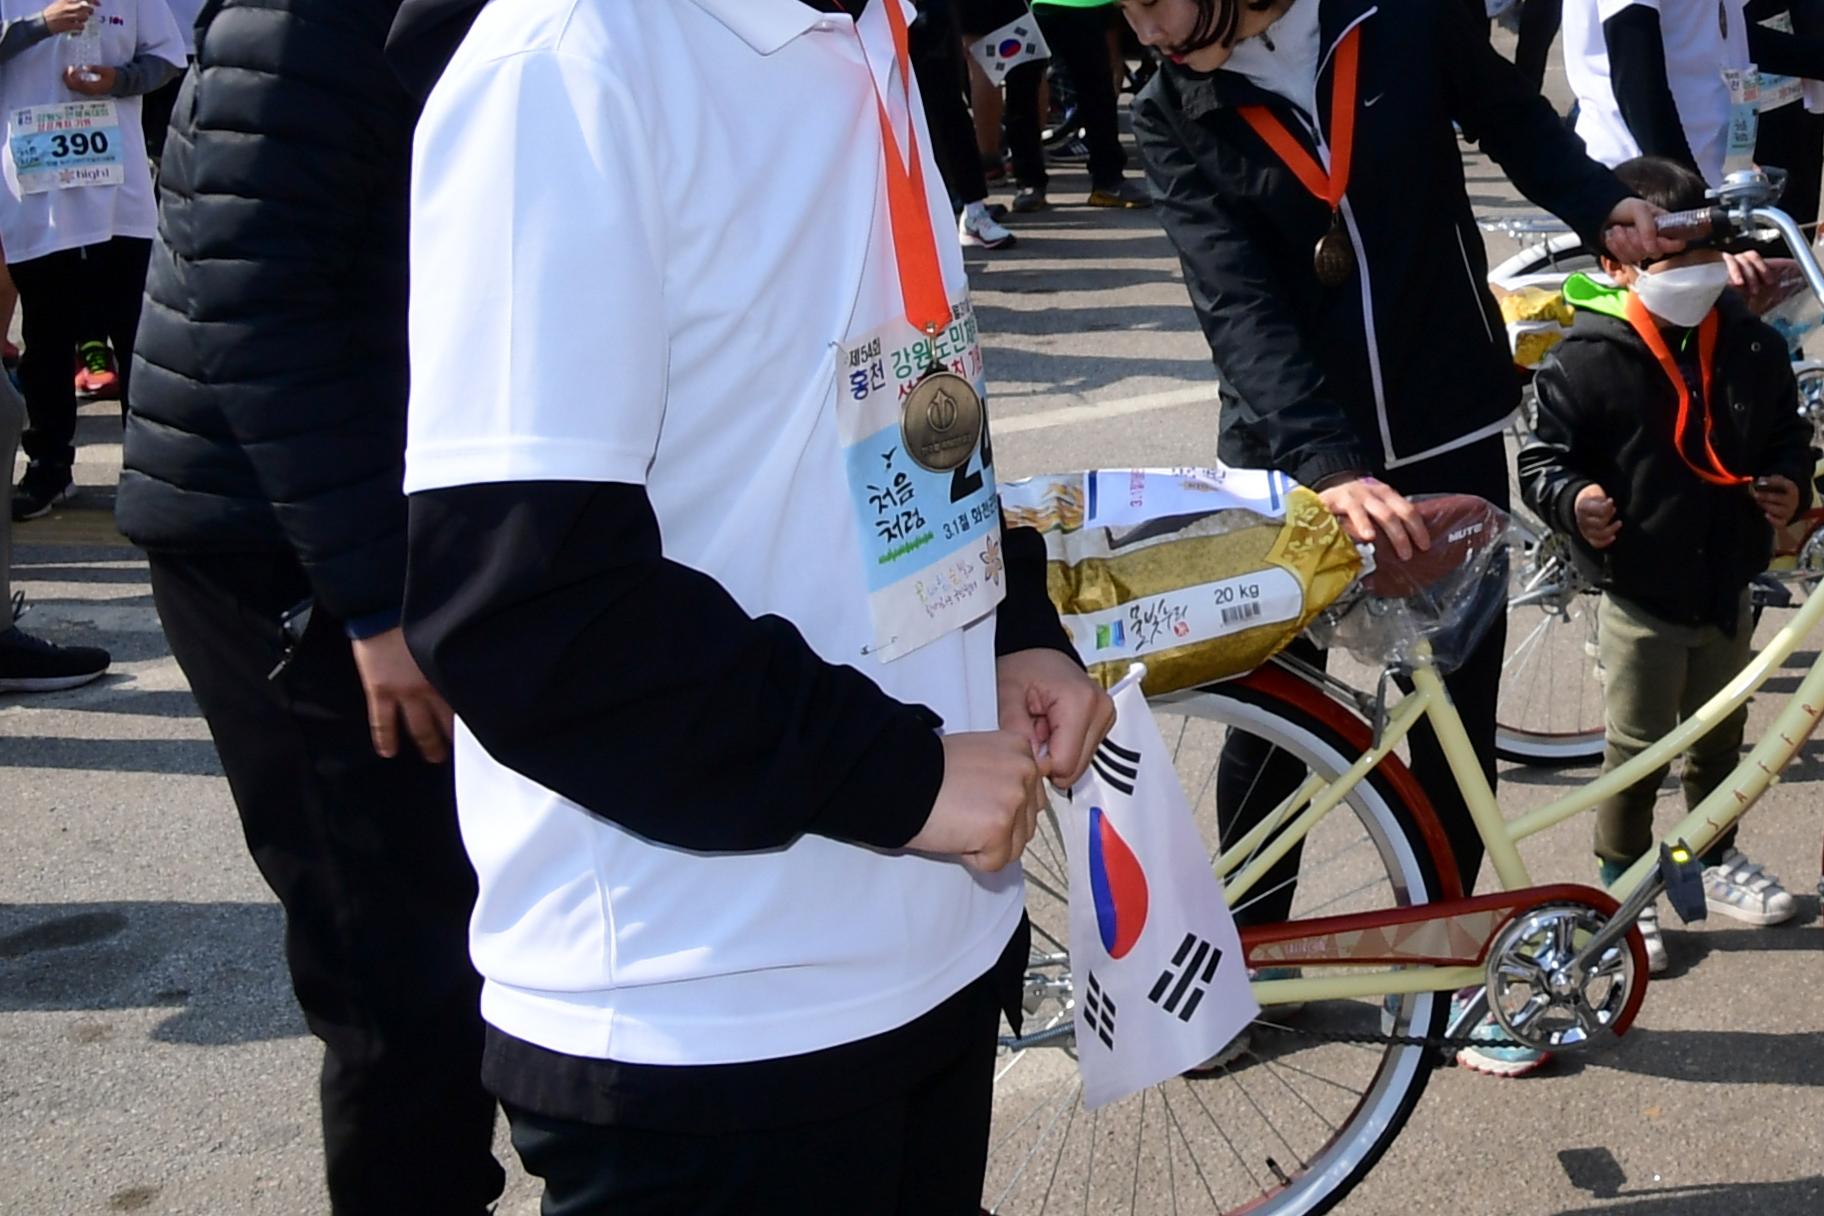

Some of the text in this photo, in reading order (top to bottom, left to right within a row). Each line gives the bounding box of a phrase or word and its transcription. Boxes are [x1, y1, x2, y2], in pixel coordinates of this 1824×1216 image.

[51, 131, 109, 158] 390
[848, 337, 881, 368] 제54회
[849, 359, 886, 401] 홍천
[866, 471, 915, 515] 처음
[875, 507, 926, 544] 처럼
[1214, 583, 1260, 605] 20 kg
